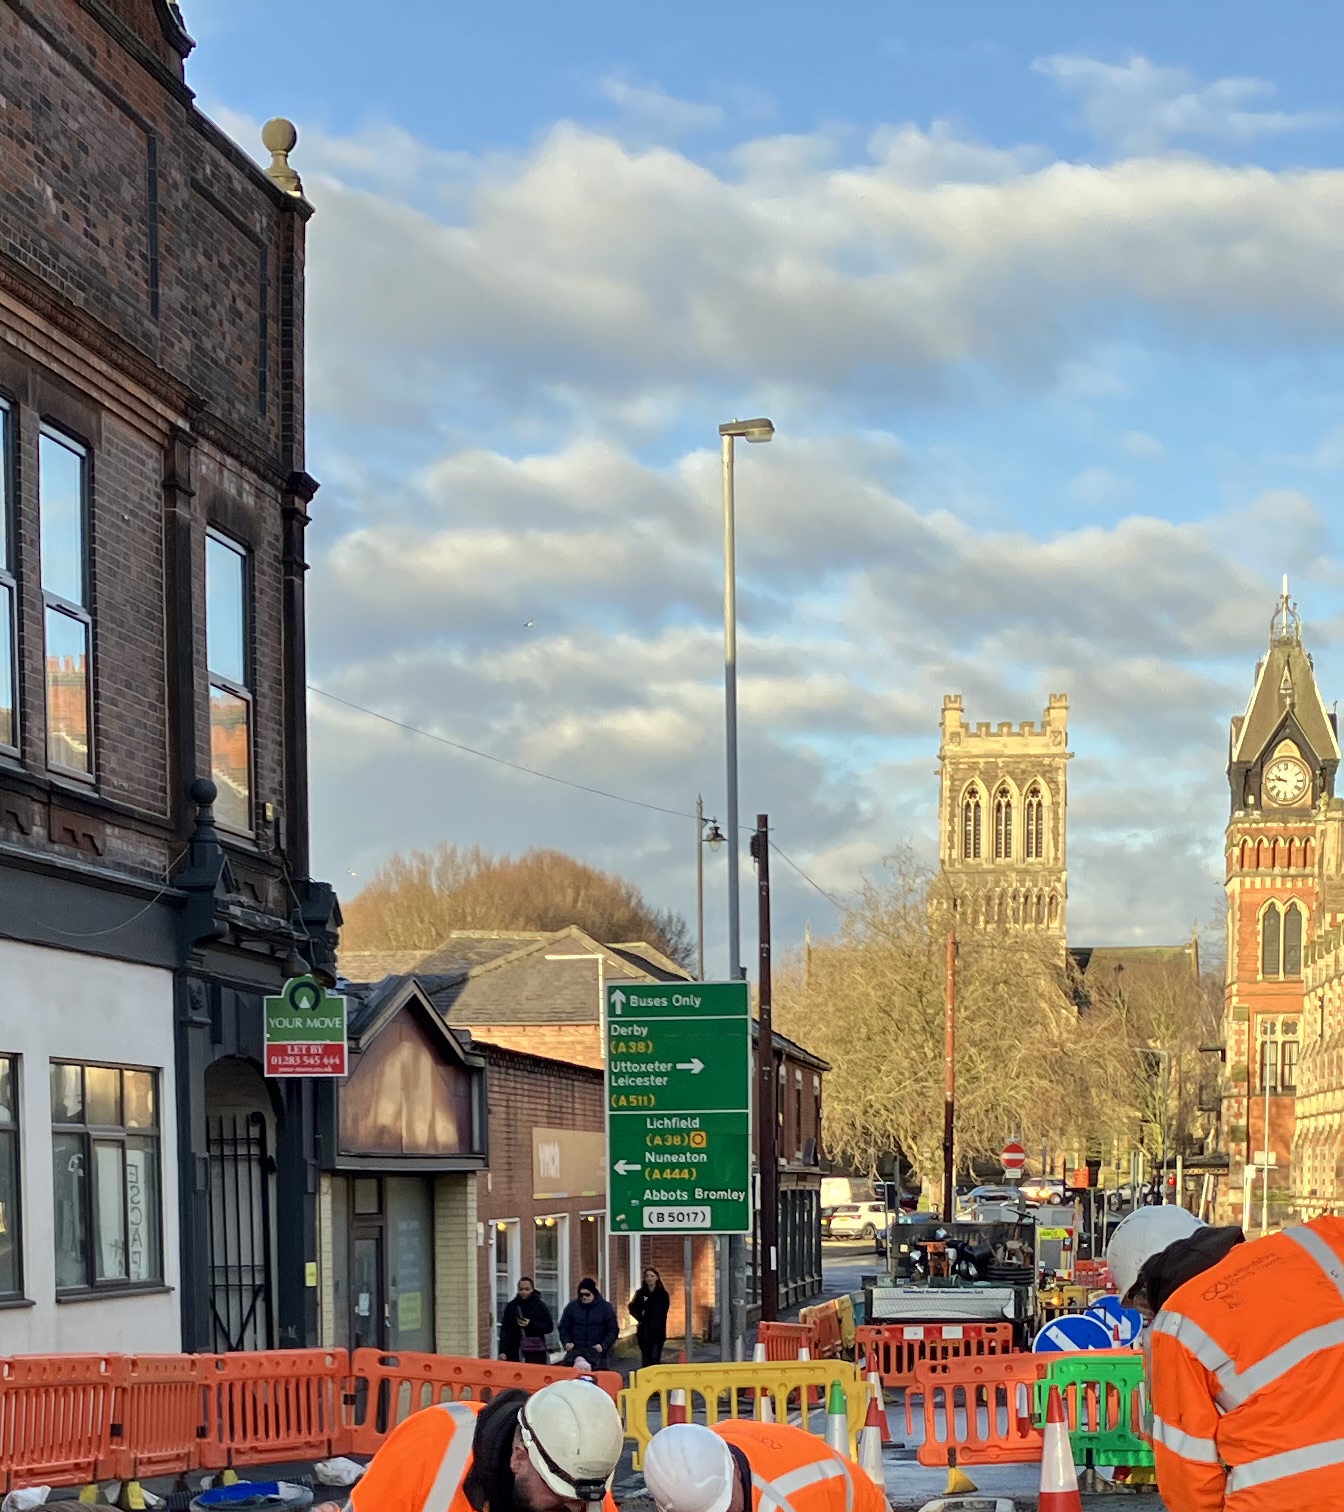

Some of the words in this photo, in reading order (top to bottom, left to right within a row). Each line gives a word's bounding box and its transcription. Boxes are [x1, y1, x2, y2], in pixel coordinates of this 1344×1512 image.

[629, 995, 668, 1007] Buses
[672, 994, 702, 1008] Only
[268, 1017, 303, 1028] YOUR
[306, 1017, 343, 1028] MOVE
[610, 1024, 649, 1038] Derby
[287, 1045, 308, 1054] LET
[309, 1045, 324, 1054] BY
[611, 1061, 674, 1073] Uttoxeter
[611, 1075, 669, 1087] Leicester
[646, 1117, 701, 1129] Lichfield
[645, 1152, 708, 1163] Nuneaton
[643, 1189, 689, 1201] Abbots
[694, 1188, 746, 1202] Bromley
